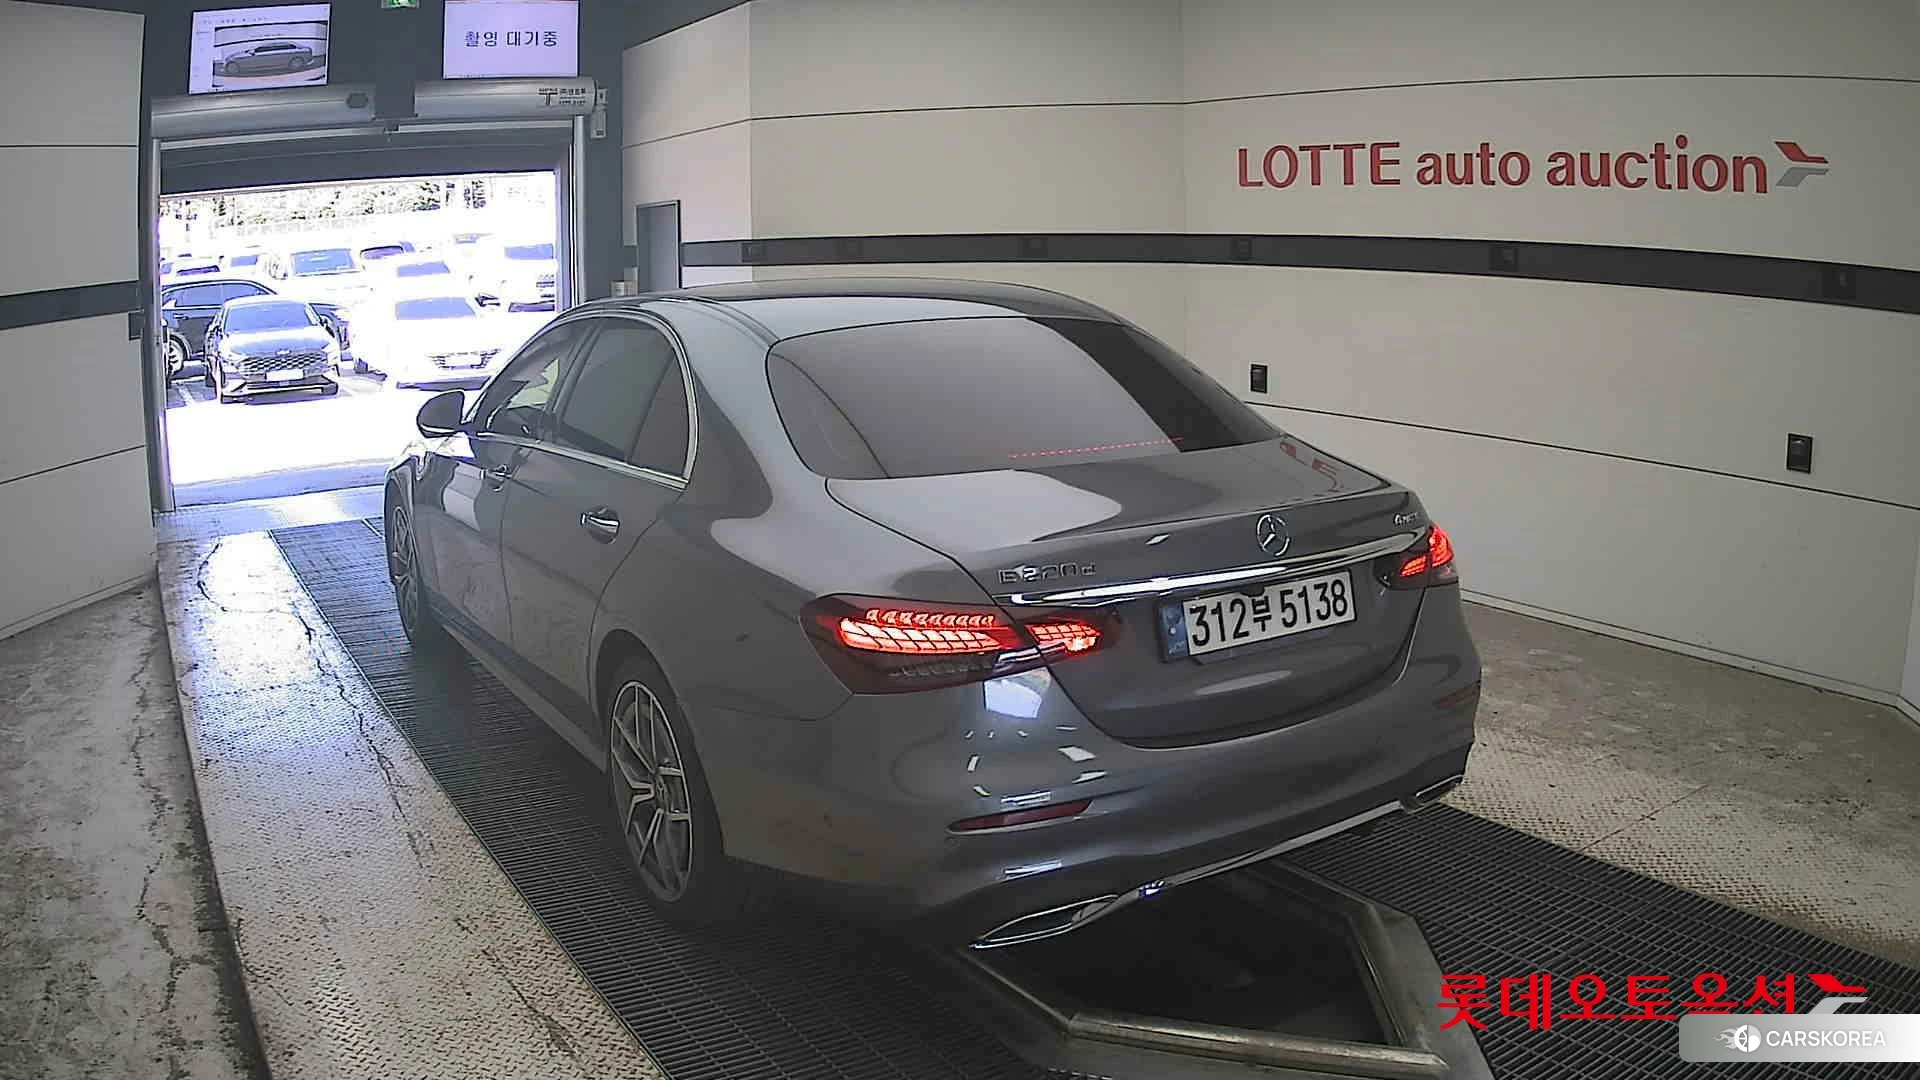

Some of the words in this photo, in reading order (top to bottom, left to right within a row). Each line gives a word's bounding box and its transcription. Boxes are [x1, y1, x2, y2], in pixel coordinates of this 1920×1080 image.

[465, 31, 497, 47] 촬영
[506, 31, 557, 47] 대기중
[1237, 141, 1401, 188] LOTTE
[1415, 141, 1531, 188] auto
[1546, 133, 1769, 194] auction
[1189, 595, 1272, 647] 312부
[1280, 578, 1349, 629] 5138
